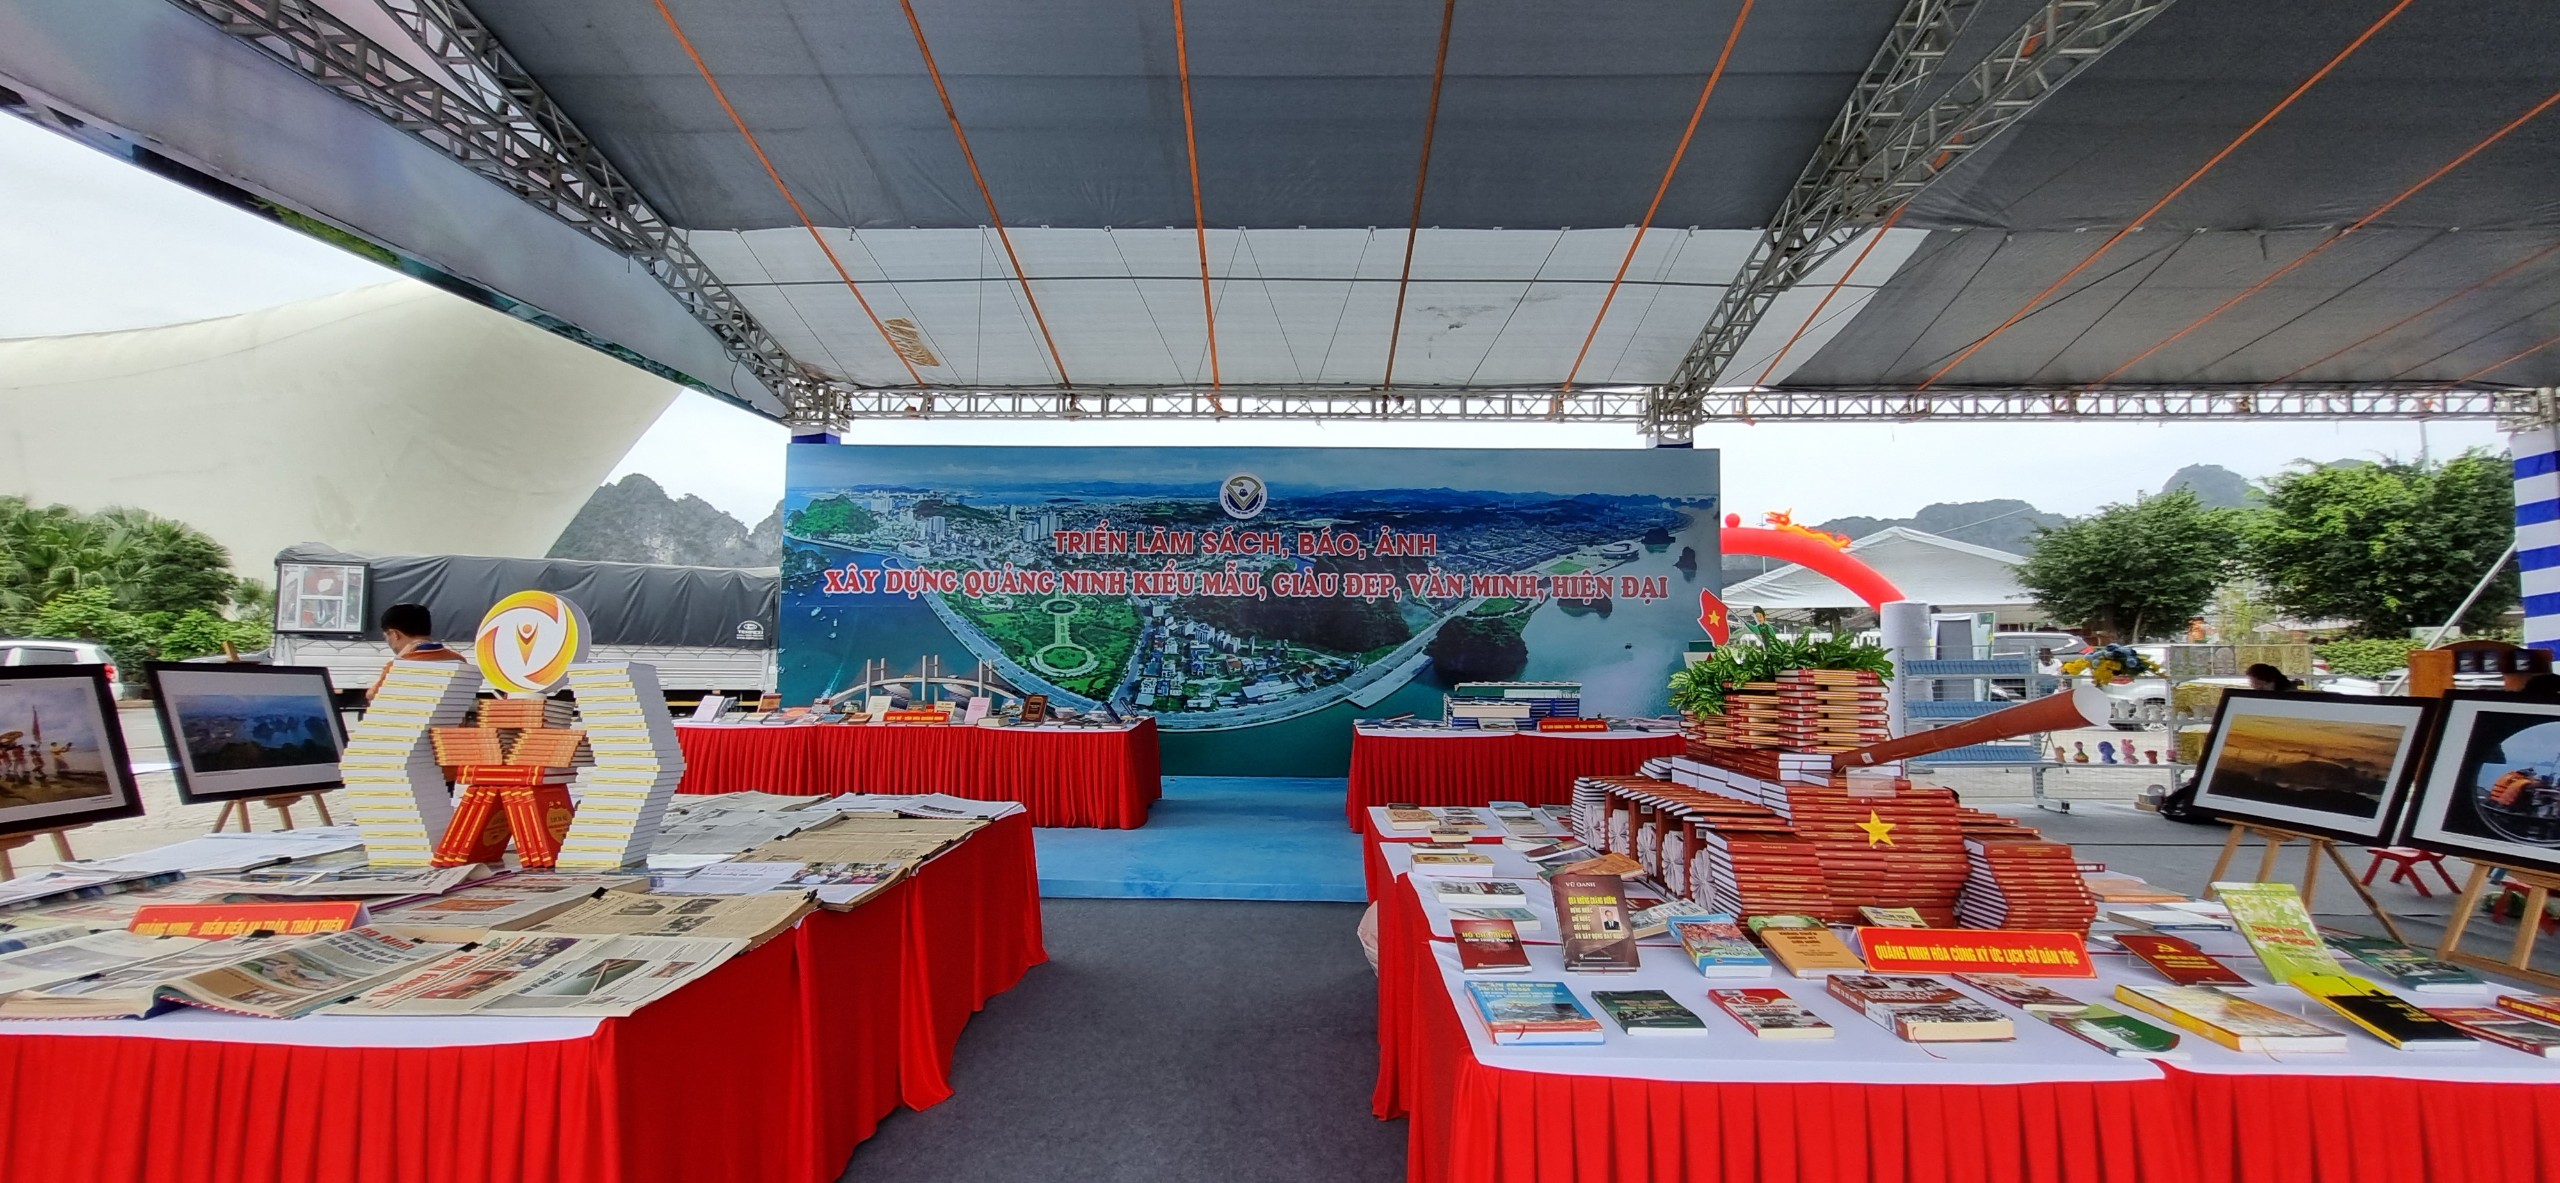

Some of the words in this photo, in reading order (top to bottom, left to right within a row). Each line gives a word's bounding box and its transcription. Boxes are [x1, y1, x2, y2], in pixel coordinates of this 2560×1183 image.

[1054, 520, 1126, 555] TRIỂN
[1202, 527, 1290, 559] SÁCH,
[1298, 527, 1367, 560] BÁO,
[1373, 525, 1437, 556] ẢNH
[824, 563, 884, 594] XÂY
[886, 566, 957, 600] DỰNG
[963, 563, 1054, 596] QUẢNG
[1062, 570, 1124, 595] NINH
[1131, 558, 1194, 596] KIỂU
[1201, 561, 1267, 601] MẪU,
[1273, 566, 1339, 597] GIÀU
[1343, 573, 1402, 603] ĐẸP,
[1408, 568, 1466, 598] VĂN
[1471, 574, 1545, 602] MINH,
[1550, 571, 1614, 604] HIỆN
[1621, 576, 1669, 604] ĐẠI
[1875, 941, 1905, 960] QUẢNG
[1907, 946, 1930, 960] NINH
[1950, 944, 1976, 962] CÙNG
[2005, 948, 2027, 966] LỊCH
[2027, 945, 2040, 964] SỬ
[2040, 947, 2061, 965] DÂN
[2061, 948, 2079, 967] TỘC
